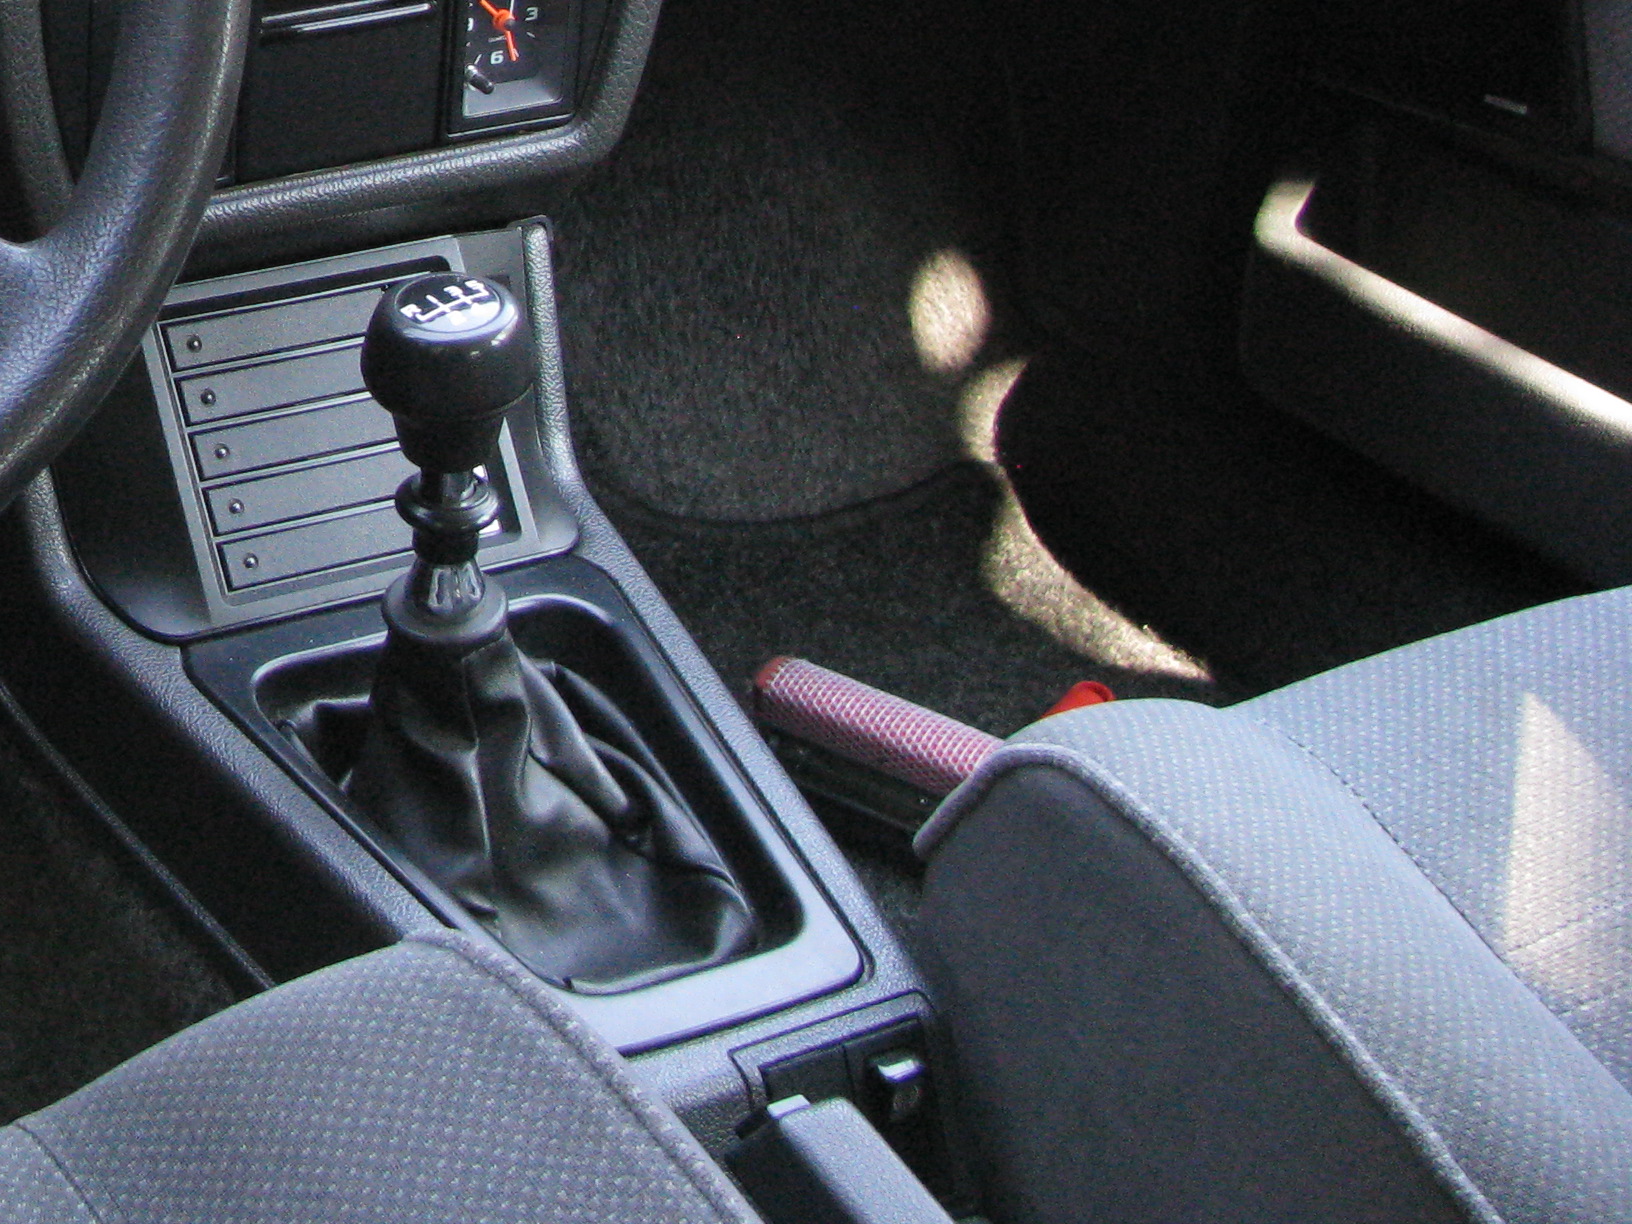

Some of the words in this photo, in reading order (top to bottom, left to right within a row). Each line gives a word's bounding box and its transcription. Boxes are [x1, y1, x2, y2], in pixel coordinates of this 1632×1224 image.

[525, 6, 539, 22] 3
[490, 50, 504, 65] 6
[400, 303, 422, 318] R
